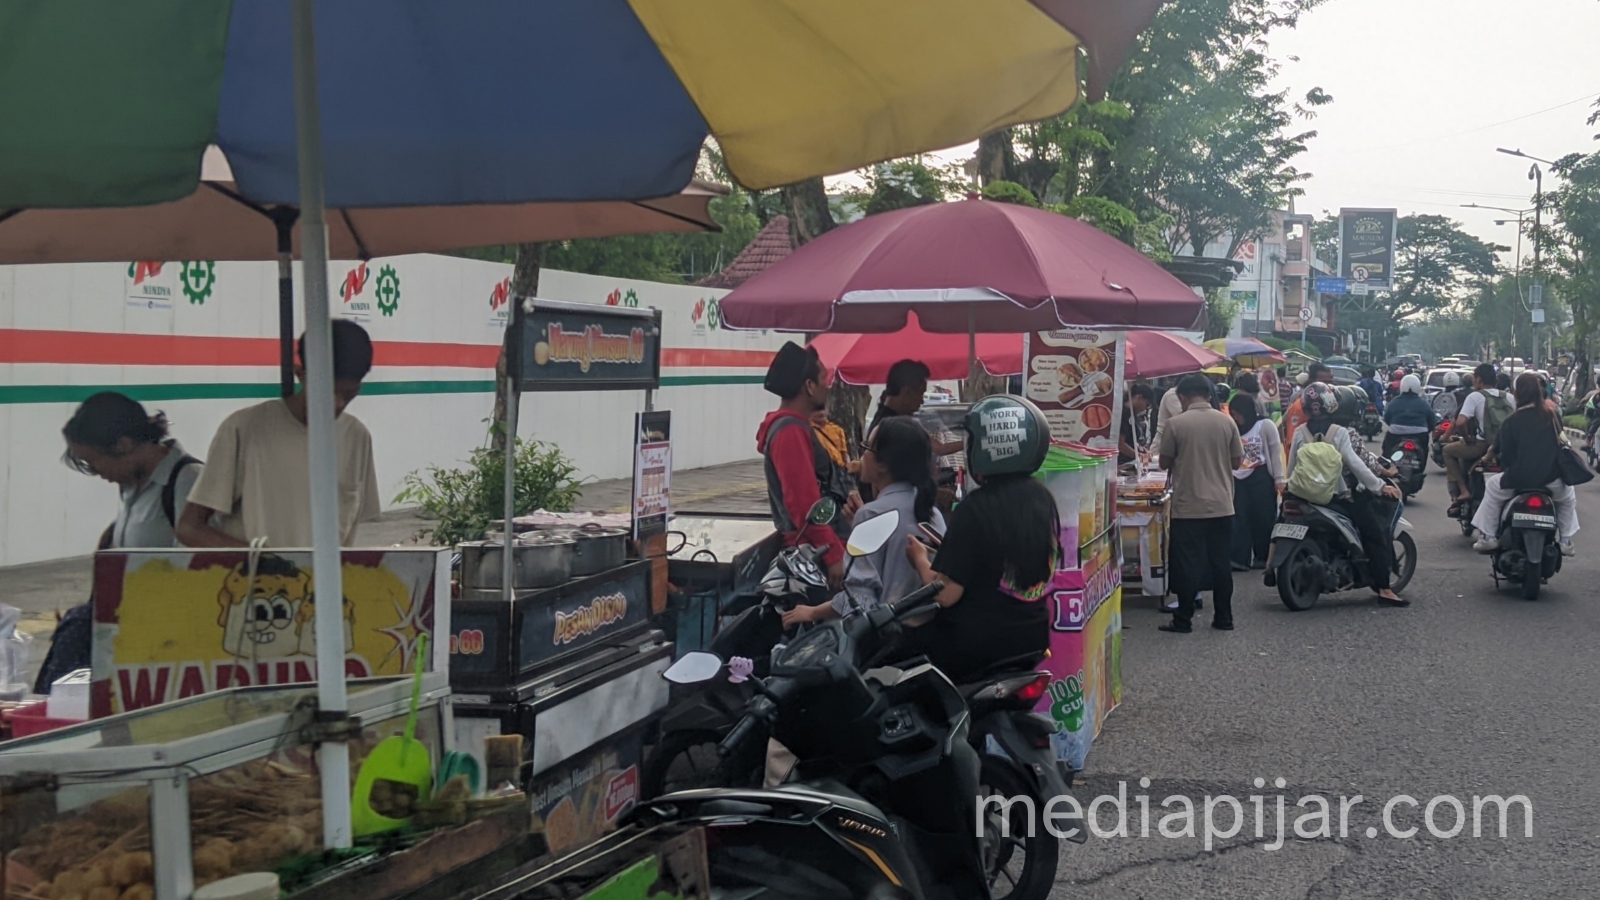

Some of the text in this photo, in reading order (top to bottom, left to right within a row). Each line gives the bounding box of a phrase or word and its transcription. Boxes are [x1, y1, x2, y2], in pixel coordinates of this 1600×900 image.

[143, 285, 171, 296] NINDYA
[989, 410, 1018, 420] WORK
[989, 421, 1017, 431] HARD
[987, 433, 1020, 445] DREAM
[996, 446, 1014, 457] BIG
[554, 591, 627, 646] PESAN DISINI
